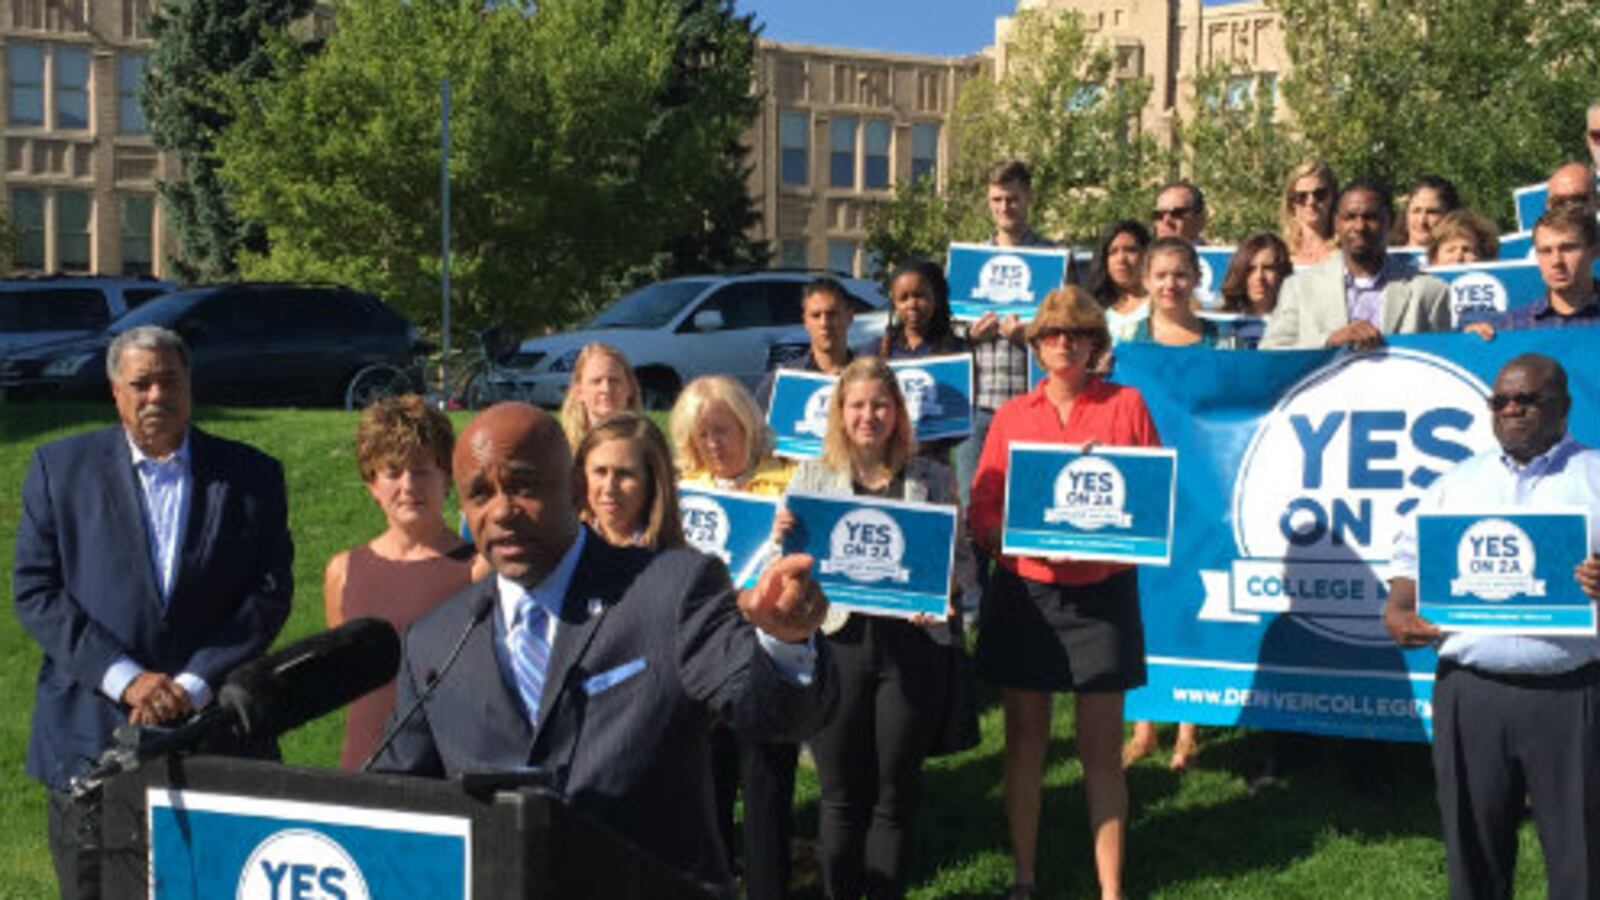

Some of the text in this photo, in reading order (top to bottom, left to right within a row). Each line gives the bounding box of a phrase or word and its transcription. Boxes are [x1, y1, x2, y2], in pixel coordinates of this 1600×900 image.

[989, 264, 1022, 279] YES
[1454, 284, 1494, 301] YES
[1290, 407, 1475, 489] YES
[1069, 470, 1113, 492] YES
[1066, 491, 1090, 506] ON
[845, 520, 892, 545] YES
[1280, 497, 1371, 547] ON
[843, 543, 892, 560] ON 2A
[1469, 535, 1520, 557] YES
[1470, 559, 1522, 574] ON 2A
[1247, 575, 1365, 600] COLLEGE
[261, 860, 347, 900] YES
